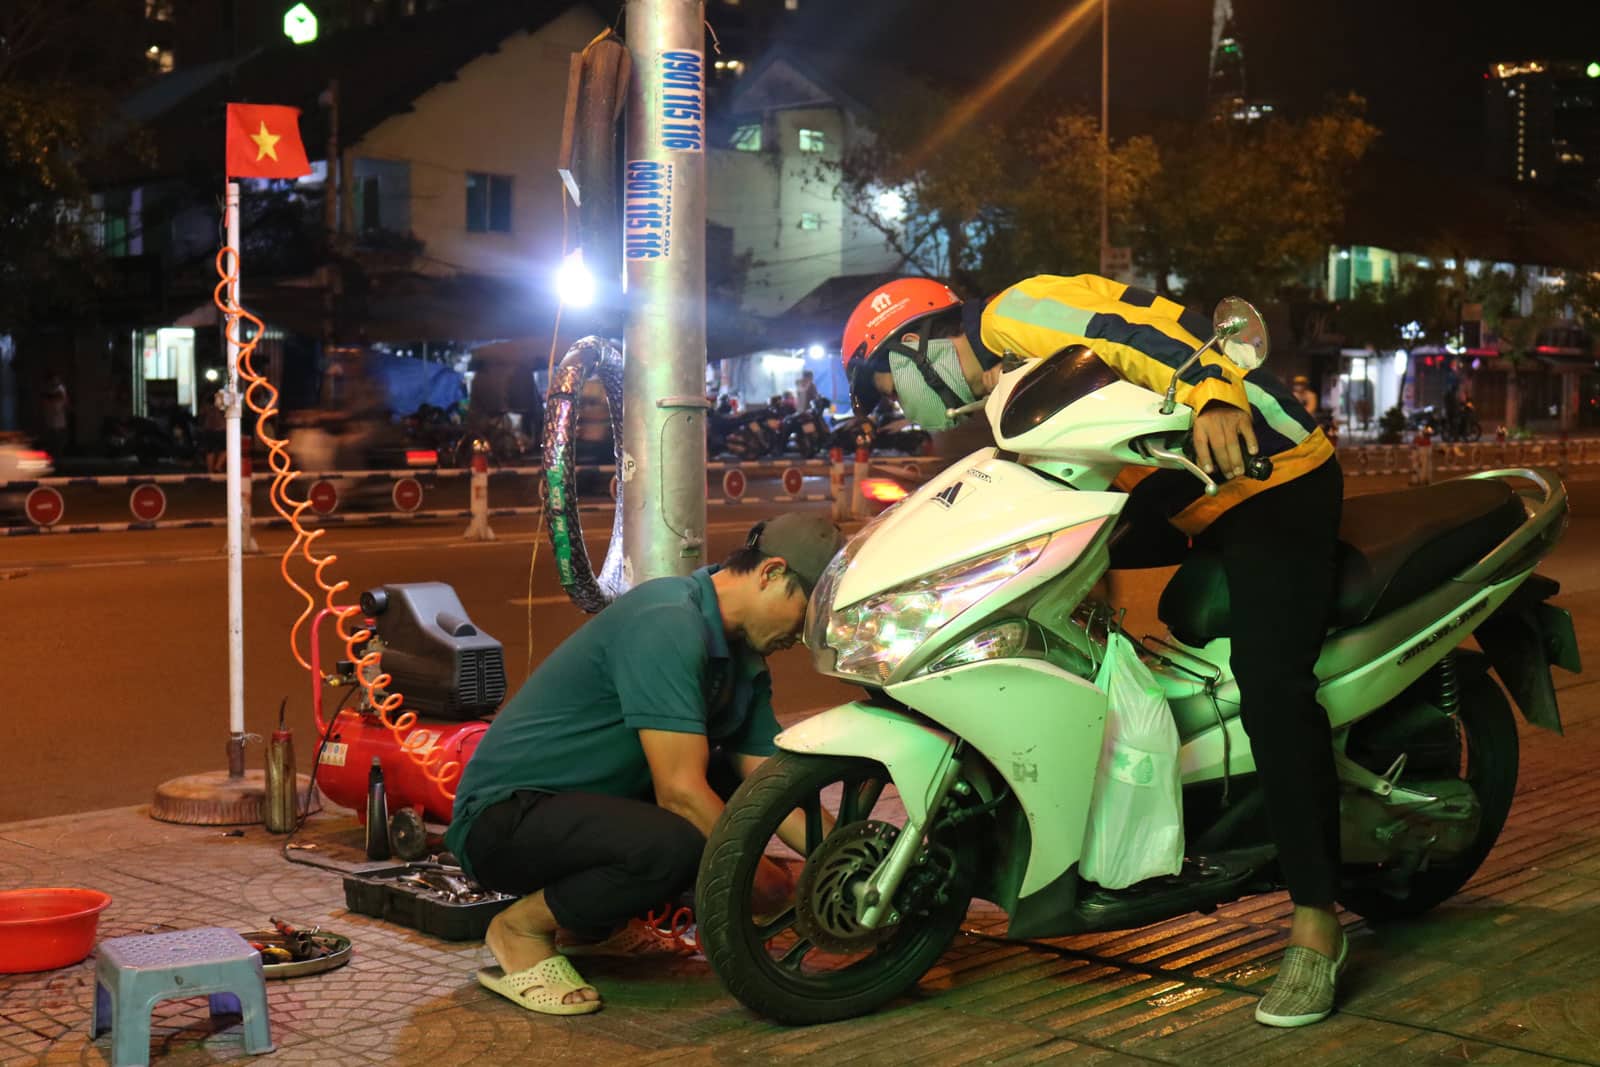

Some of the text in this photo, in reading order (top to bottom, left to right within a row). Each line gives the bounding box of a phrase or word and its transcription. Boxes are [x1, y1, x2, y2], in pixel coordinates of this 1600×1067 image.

[661, 51, 701, 150] 0901 115 116
[626, 161, 665, 259] 0901 115 116
